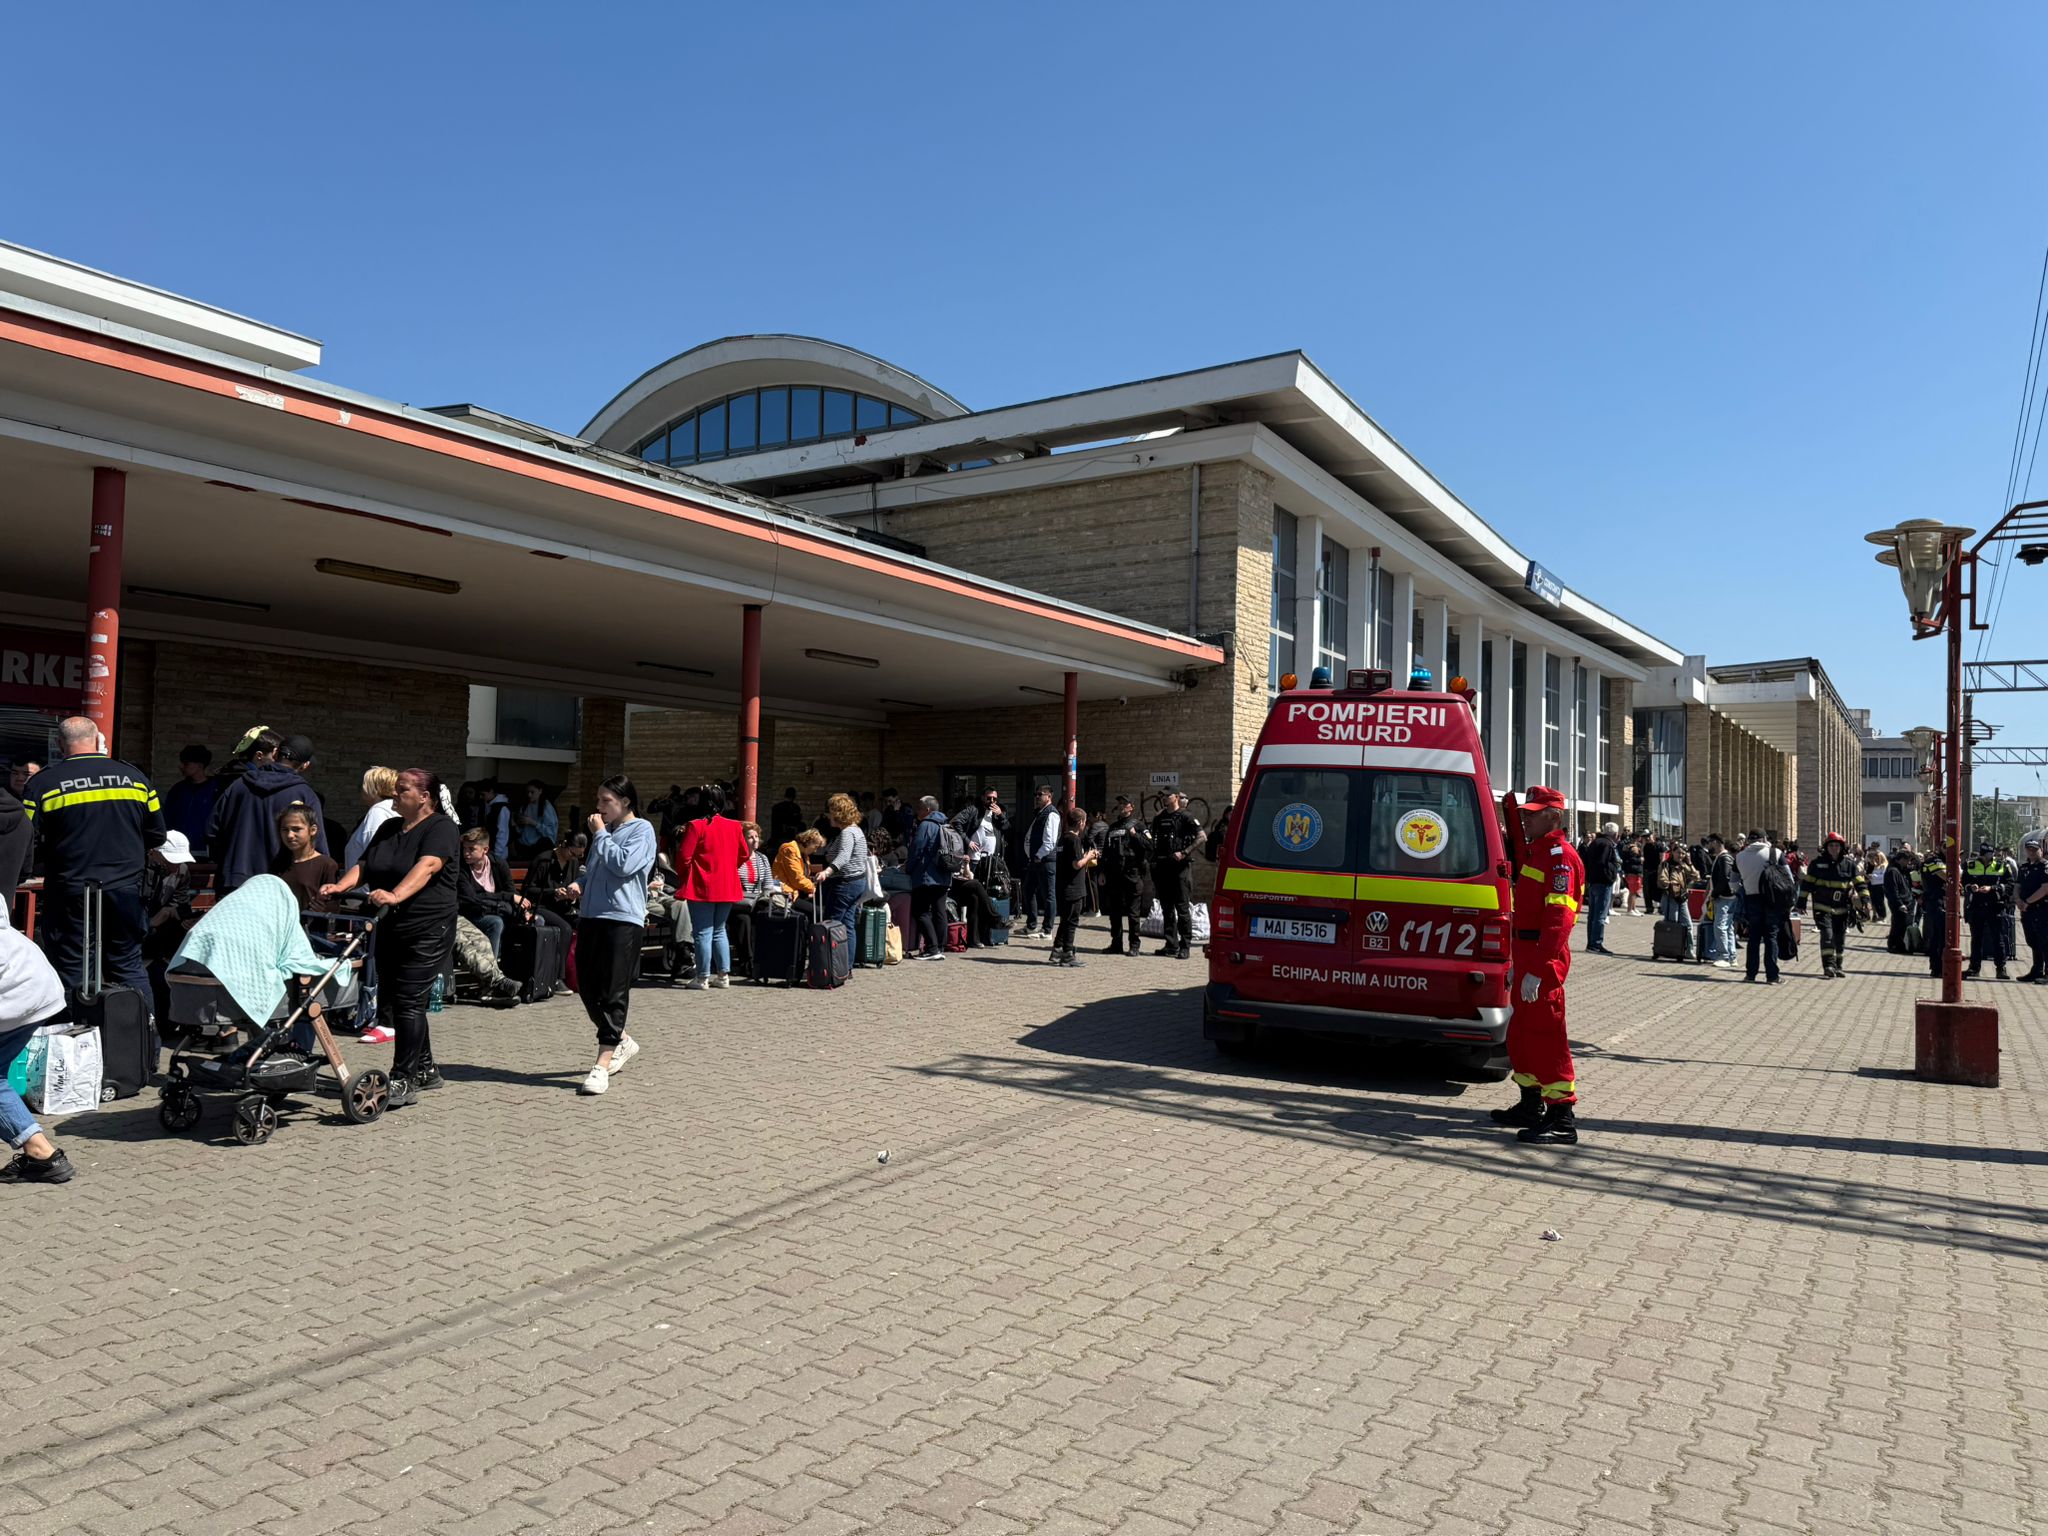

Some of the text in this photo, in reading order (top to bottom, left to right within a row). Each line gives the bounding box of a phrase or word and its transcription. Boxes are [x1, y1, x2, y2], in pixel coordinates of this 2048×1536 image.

[1288, 703, 1446, 727] POMPIERII
[1317, 724, 1412, 743] SMURD
[1152, 775, 1177, 783] LINIA 1
[1264, 919, 1327, 938] MAI 51516
[1369, 938, 1383, 948] B2
[1416, 921, 1476, 956] 112
[1272, 964, 1328, 982] ECHIPAJ
[1332, 970, 1366, 986] PRIM
